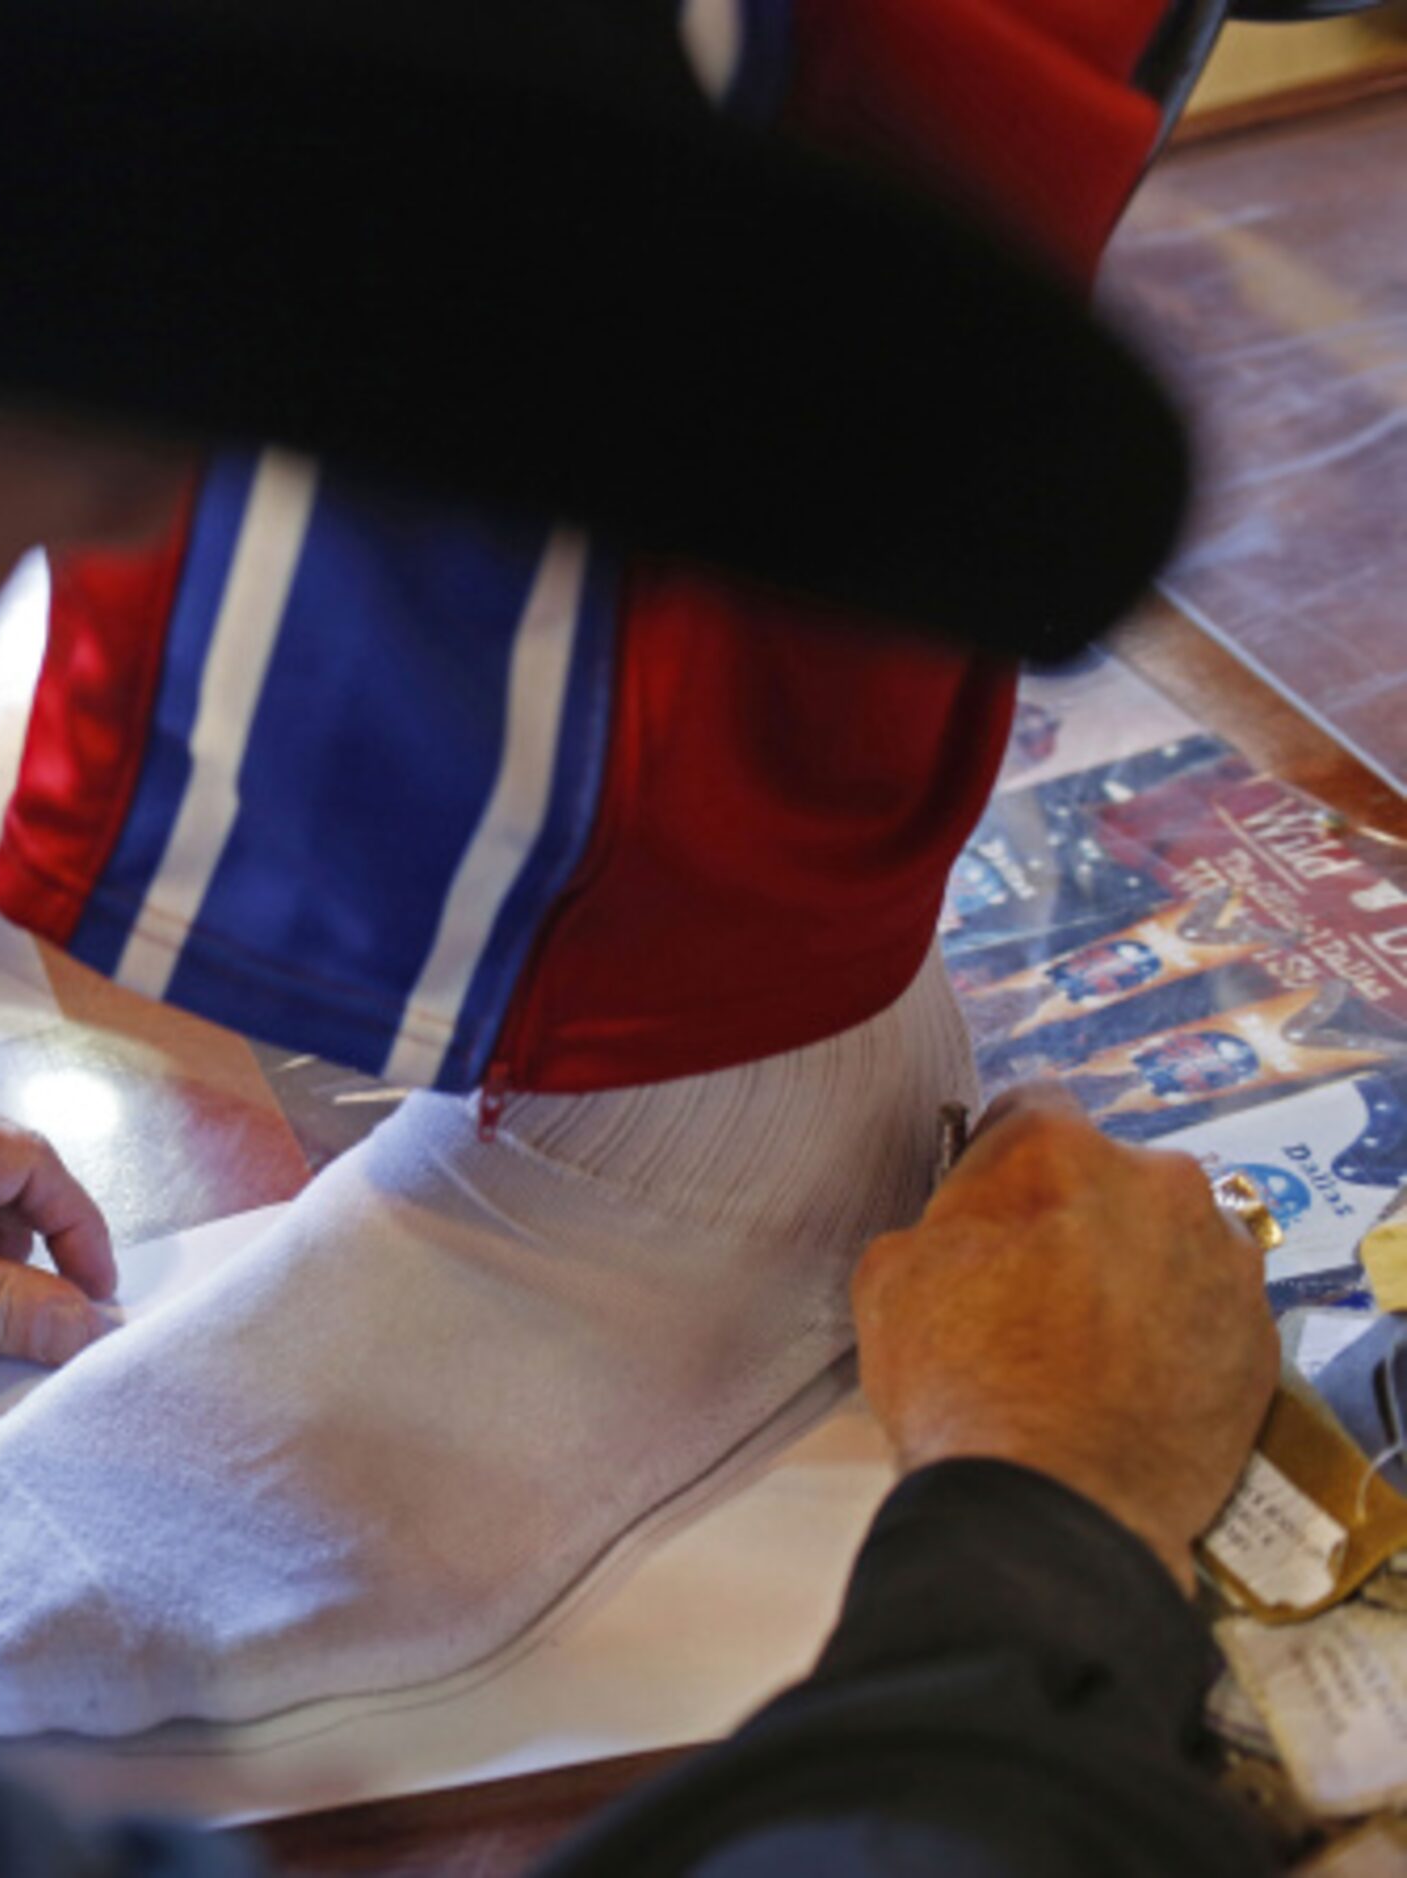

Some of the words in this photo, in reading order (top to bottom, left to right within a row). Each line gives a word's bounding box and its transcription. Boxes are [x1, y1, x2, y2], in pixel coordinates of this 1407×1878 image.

[1243, 797, 1363, 881] Wild
[1312, 939, 1392, 1001] Dallas
[1282, 1142, 1356, 1217] Dallas
